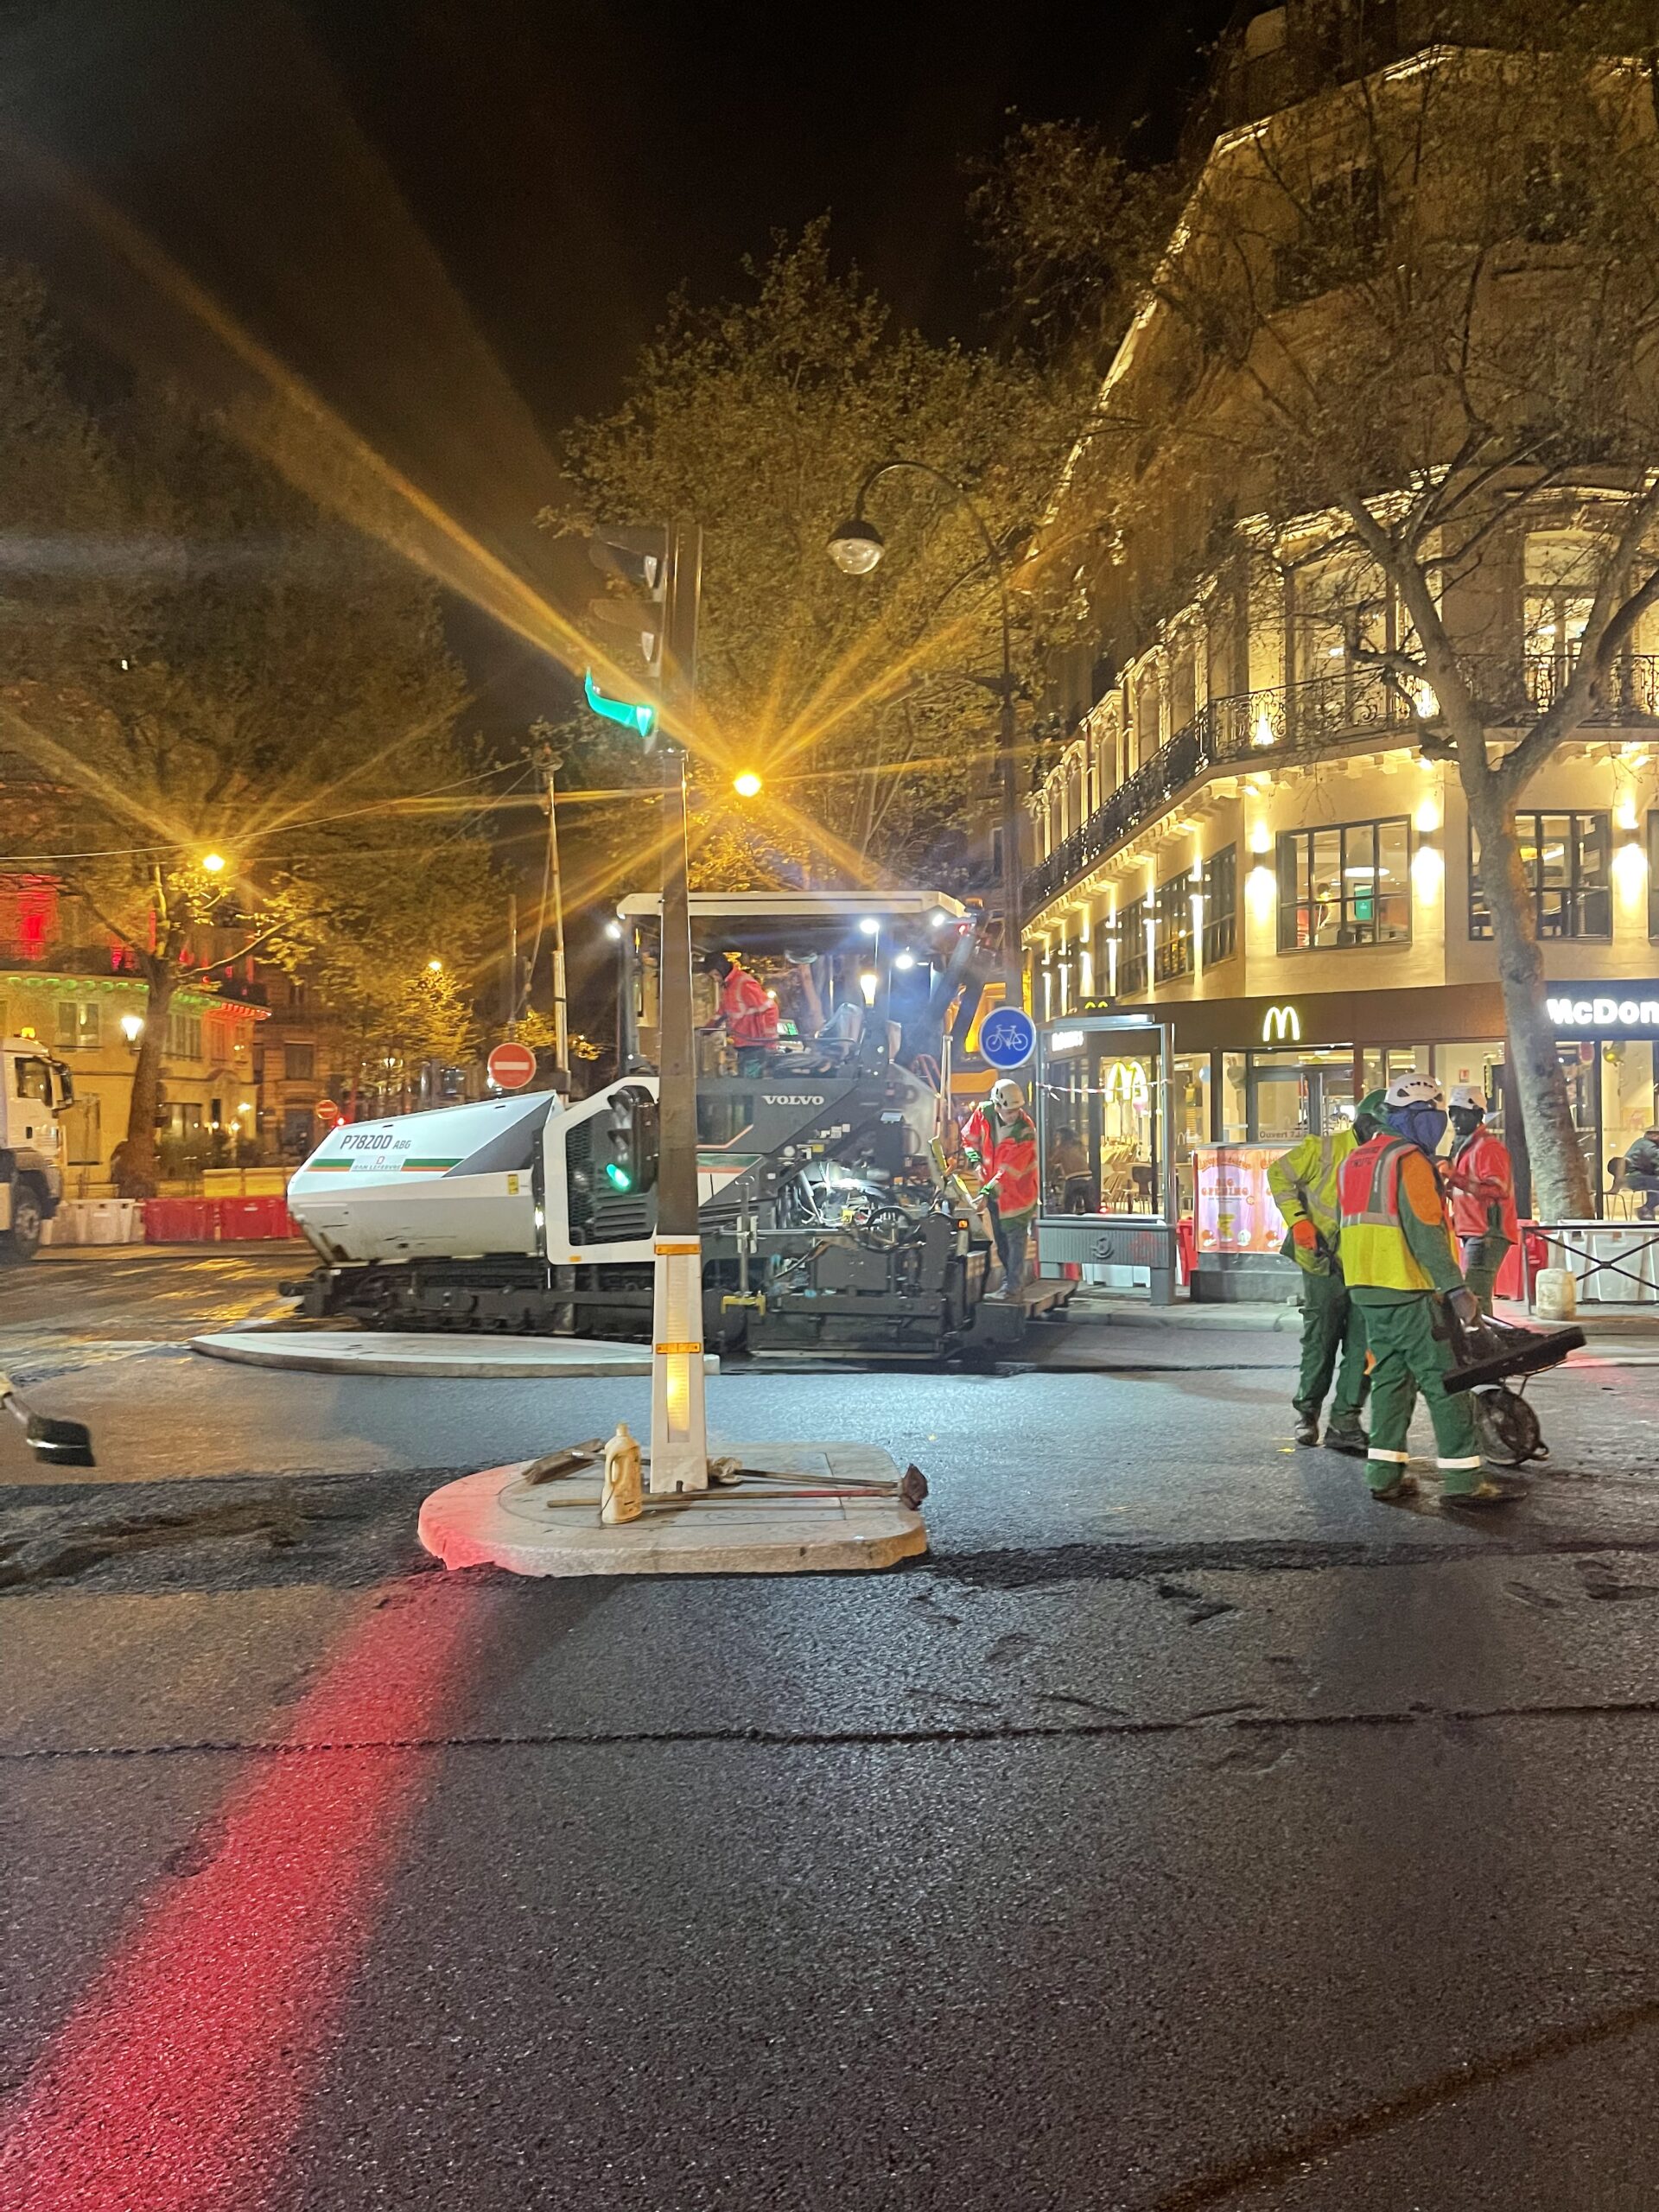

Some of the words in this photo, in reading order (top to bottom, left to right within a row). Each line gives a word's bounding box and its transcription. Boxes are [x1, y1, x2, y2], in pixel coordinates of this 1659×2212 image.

[761, 1095, 824, 1106] VOLVO
[1259, 1130, 1287, 1139] Ouvert
[340, 1135, 393, 1150] P7820D
[392, 1140, 412, 1150] ABG
